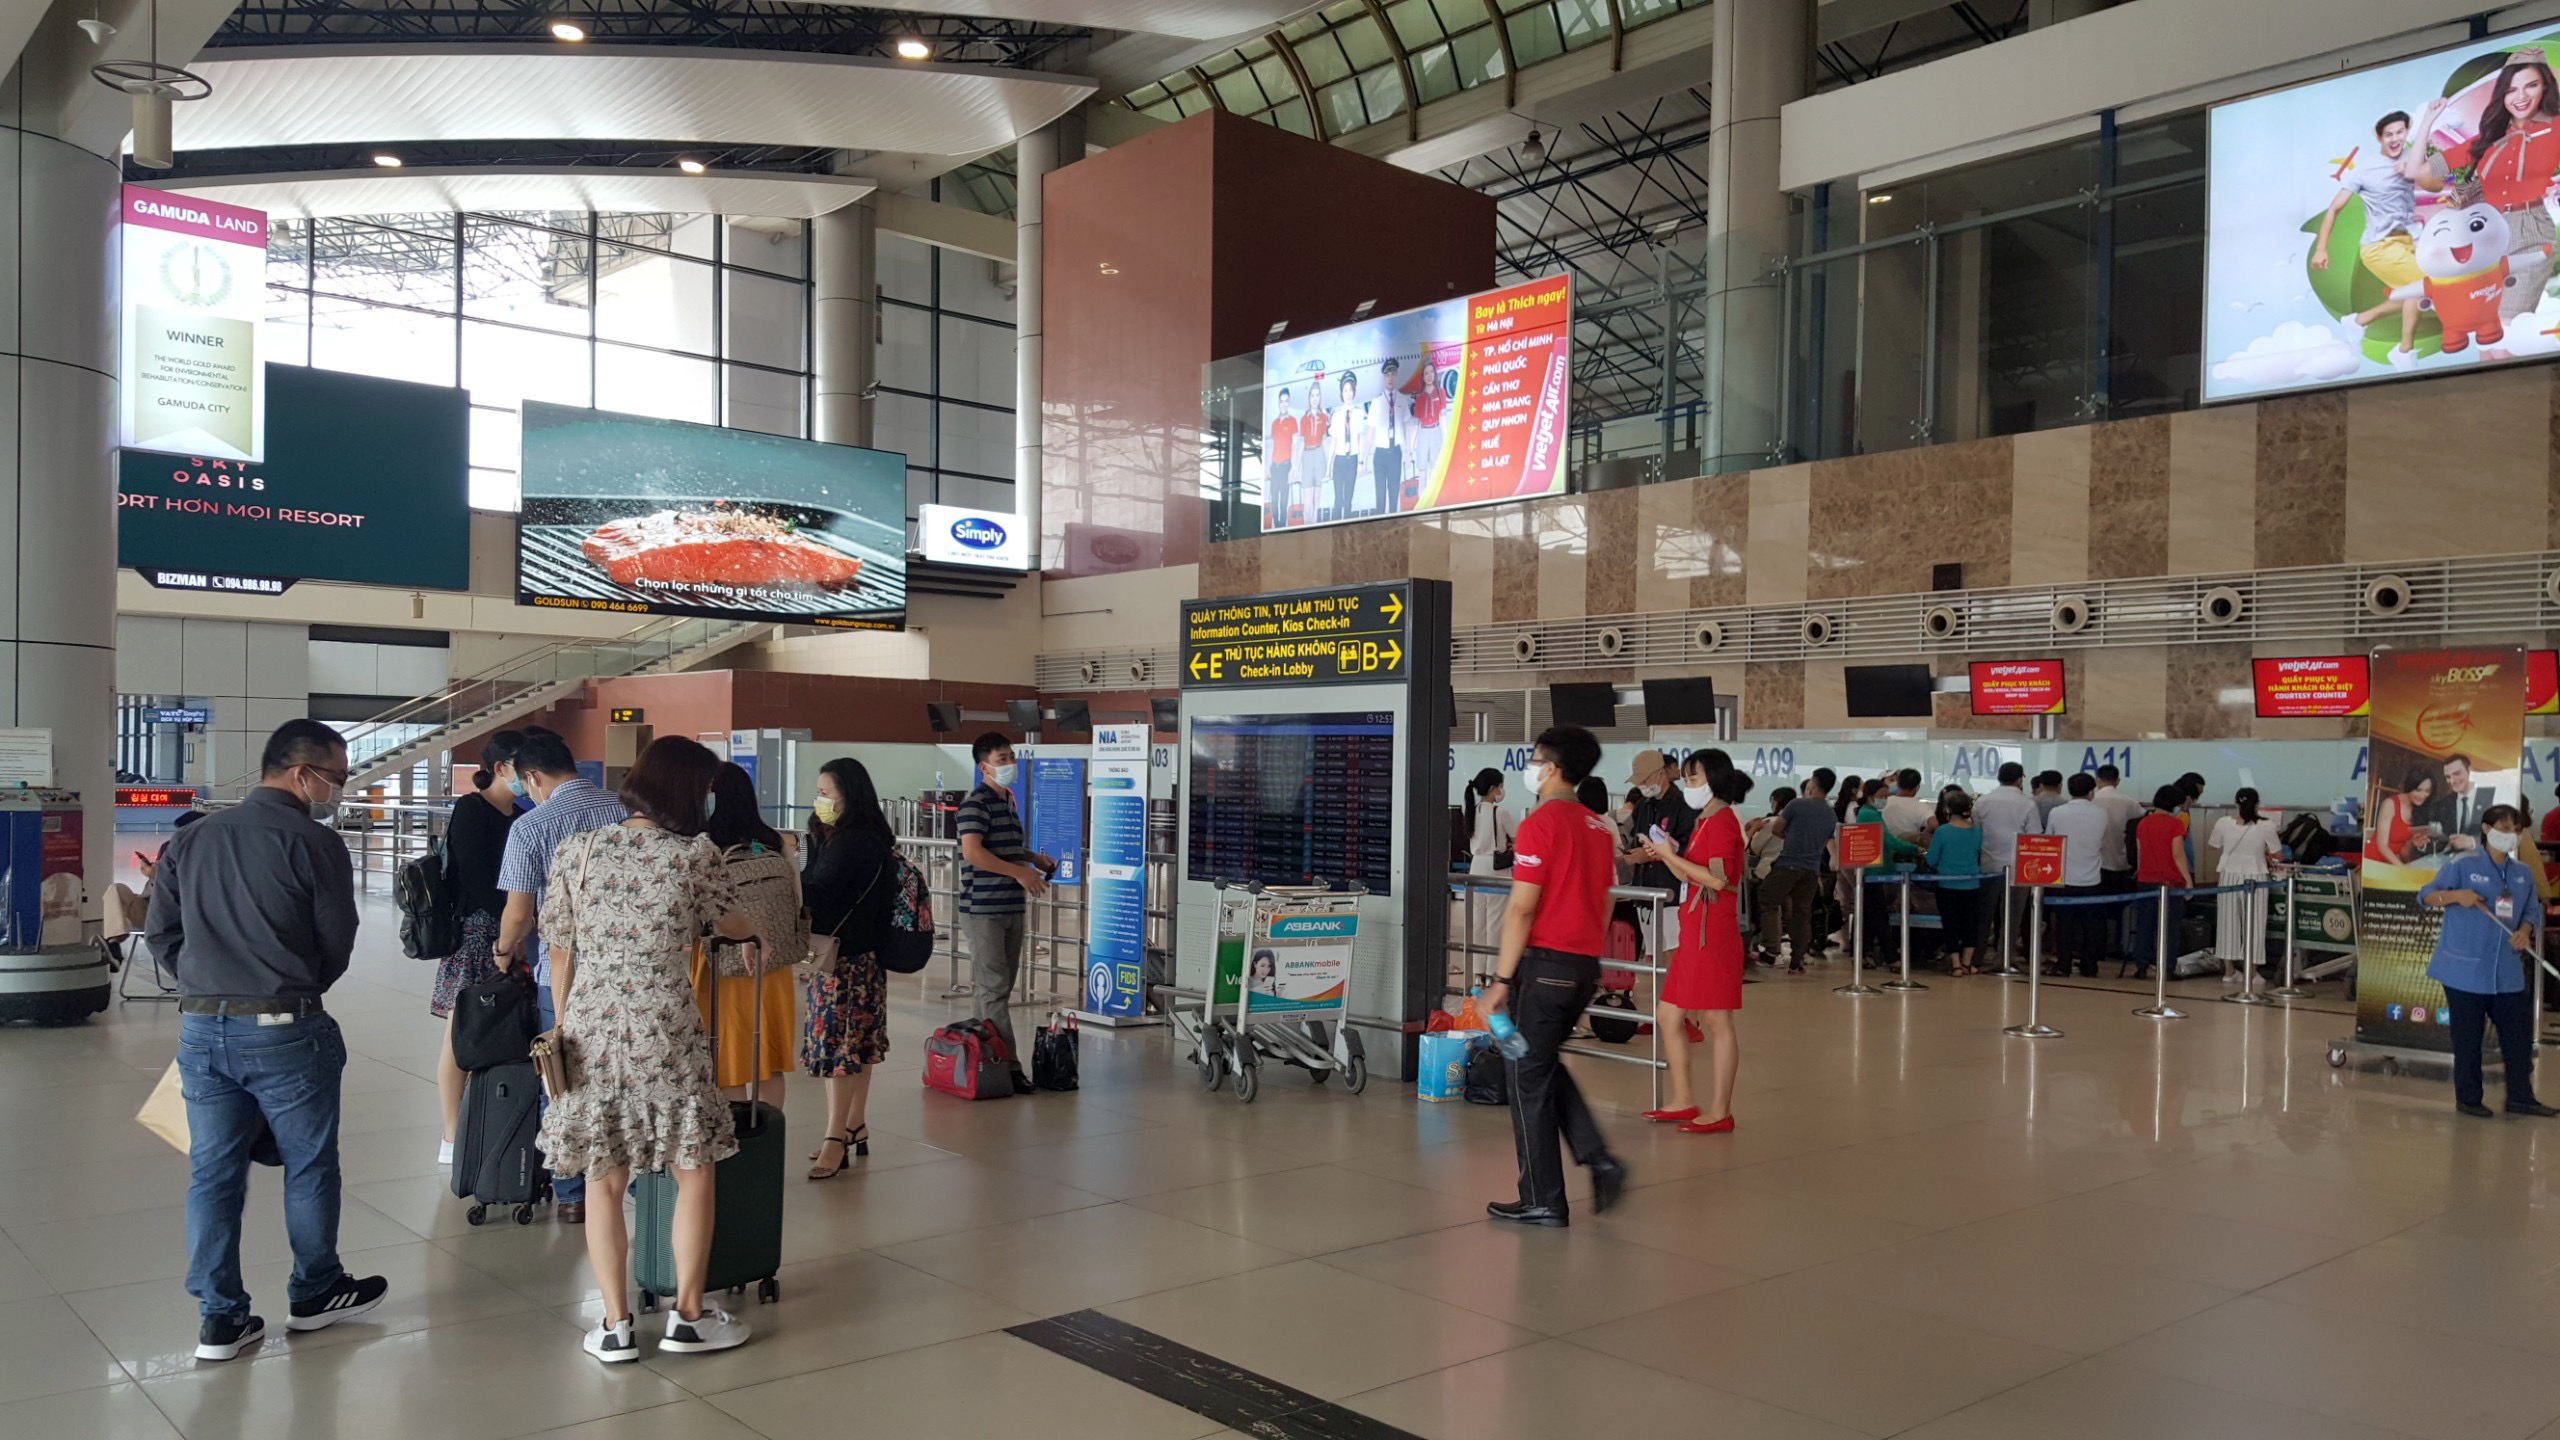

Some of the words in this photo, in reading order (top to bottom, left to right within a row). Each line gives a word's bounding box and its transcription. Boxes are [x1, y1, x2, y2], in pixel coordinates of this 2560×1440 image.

[133, 200, 211, 226] GAMUDA
[215, 215, 259, 234] LAND
[1475, 306, 1494, 319] Bay
[1496, 301, 1507, 314] là
[1508, 293, 1535, 311] Thích
[1537, 286, 1567, 306] ngay!
[1486, 320, 1498, 332] Hà
[1500, 317, 1514, 330] Nội
[166, 329, 225, 348] WINNER
[1483, 345, 1496, 357] TP.
[1528, 333, 1554, 348] MINH
[154, 354, 166, 362] THE
[168, 356, 192, 366] WORLD
[193, 360, 212, 368] GOLD
[213, 363, 236, 372] AWARD
[160, 365, 174, 373] FOR
[1502, 354, 1527, 373] QUỐC
[157, 397, 206, 411] GAMUDA
[207, 404, 231, 413] CITY
[1482, 401, 1501, 413] NHA
[1502, 395, 1531, 409] TRANG
[1482, 417, 1500, 432] QUY
[172, 470, 265, 491] OASIS
[165, 498, 219, 515] HƠN
[226, 504, 271, 521] MỌI
[278, 508, 365, 528] RESORT
[955, 520, 1004, 546] Simply
[157, 572, 207, 587] BIZMAN
[635, 577, 668, 591] Chọn
[672, 581, 690, 593] lọc
[693, 584, 733, 597] những
[736, 587, 748, 598] gì
[750, 586, 766, 600] tốt
[770, 589, 791, 600] cho
[534, 597, 579, 608] GOLDSUN
[590, 601, 607, 610] 090
[609, 601, 625, 611] 464
[627, 604, 649, 613] 6699
[1218, 605, 1251, 622] THÔNG
[1253, 605, 1271, 619] TIN,
[1273, 603, 1288, 619] TỰ
[1290, 599, 1312, 616] LÀM
[1337, 597, 1359, 613] TỤC
[1190, 624, 1240, 640] Information
[1241, 622, 1280, 635] Counter,
[1282, 619, 1304, 633] Kios
[1306, 615, 1351, 631] Check-in
[1244, 645, 1264, 662] TỤC
[1266, 642, 1296, 659] HÀNG
[1297, 639, 1336, 657] KHÔNG
[1362, 642, 1379, 671] B
[1209, 652, 1223, 679] E
[1240, 664, 1281, 678] Check-in
[1283, 662, 1314, 679] Lobby
[2291, 683, 2318, 691] KHÁCH
[1098, 730, 1118, 744] NIA
[1151, 748, 1168, 768] 03
[1752, 747, 1794, 775] A09
[1952, 746, 2000, 777] A10
[2079, 745, 2131, 778] A11
[2328, 917, 2345, 928] 500
[1120, 970, 1137, 985] FIDS
